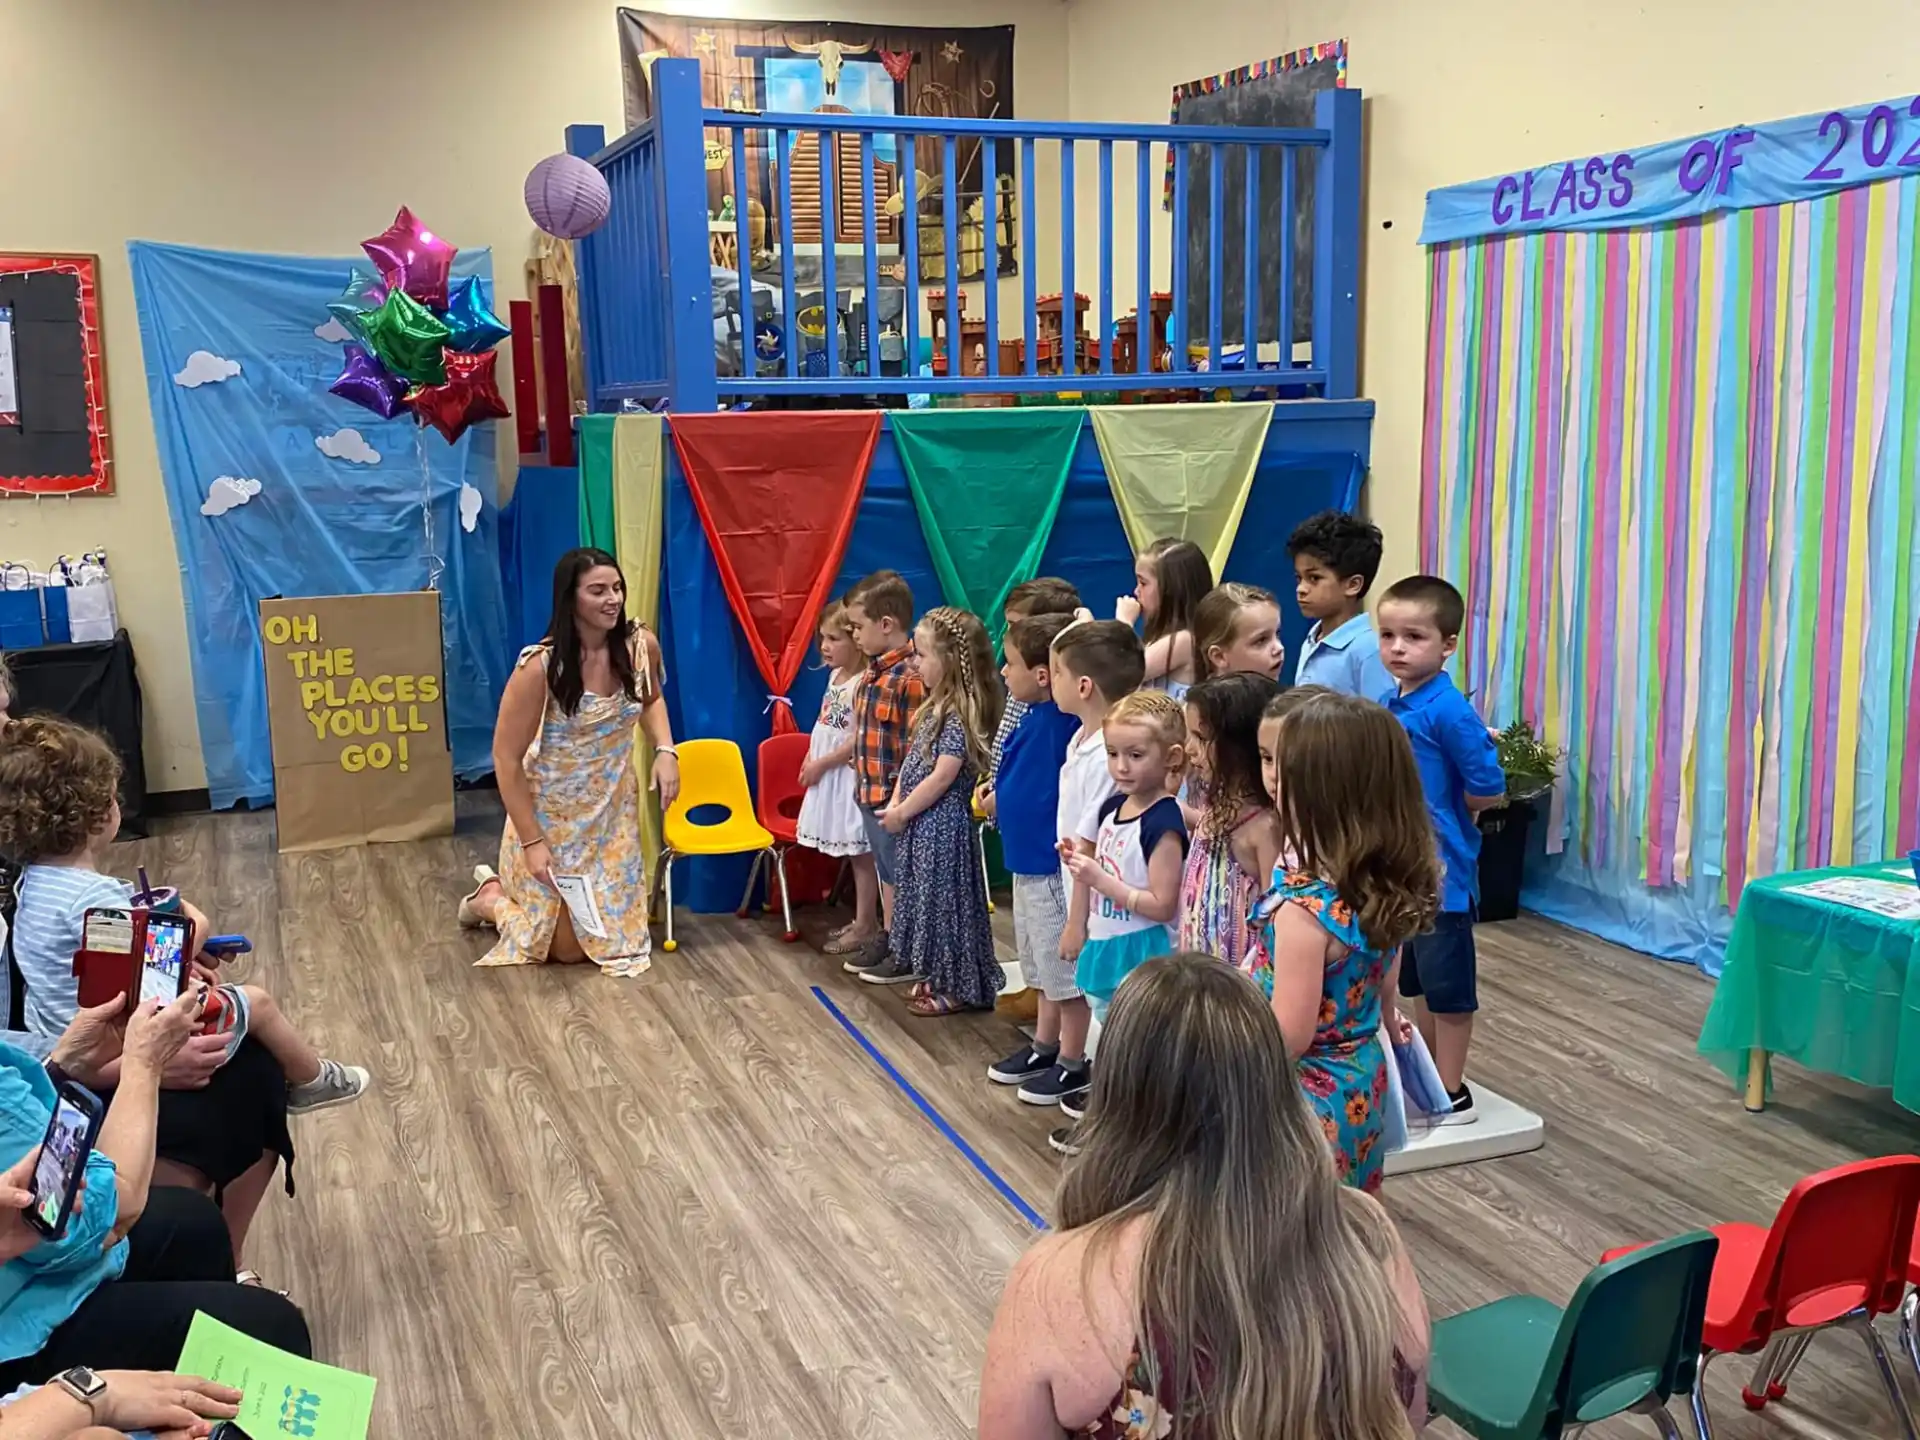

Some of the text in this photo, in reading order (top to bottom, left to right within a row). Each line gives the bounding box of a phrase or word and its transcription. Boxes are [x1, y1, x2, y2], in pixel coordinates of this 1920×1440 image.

[704, 149, 724, 160] EST
[1492, 154, 1634, 225] CLASS
[1678, 129, 1757, 195] OF
[287, 648, 355, 679] THE
[301, 674, 440, 710] PLACES
[307, 704, 429, 740] YOU'LL
[340, 735, 409, 772] GO!
